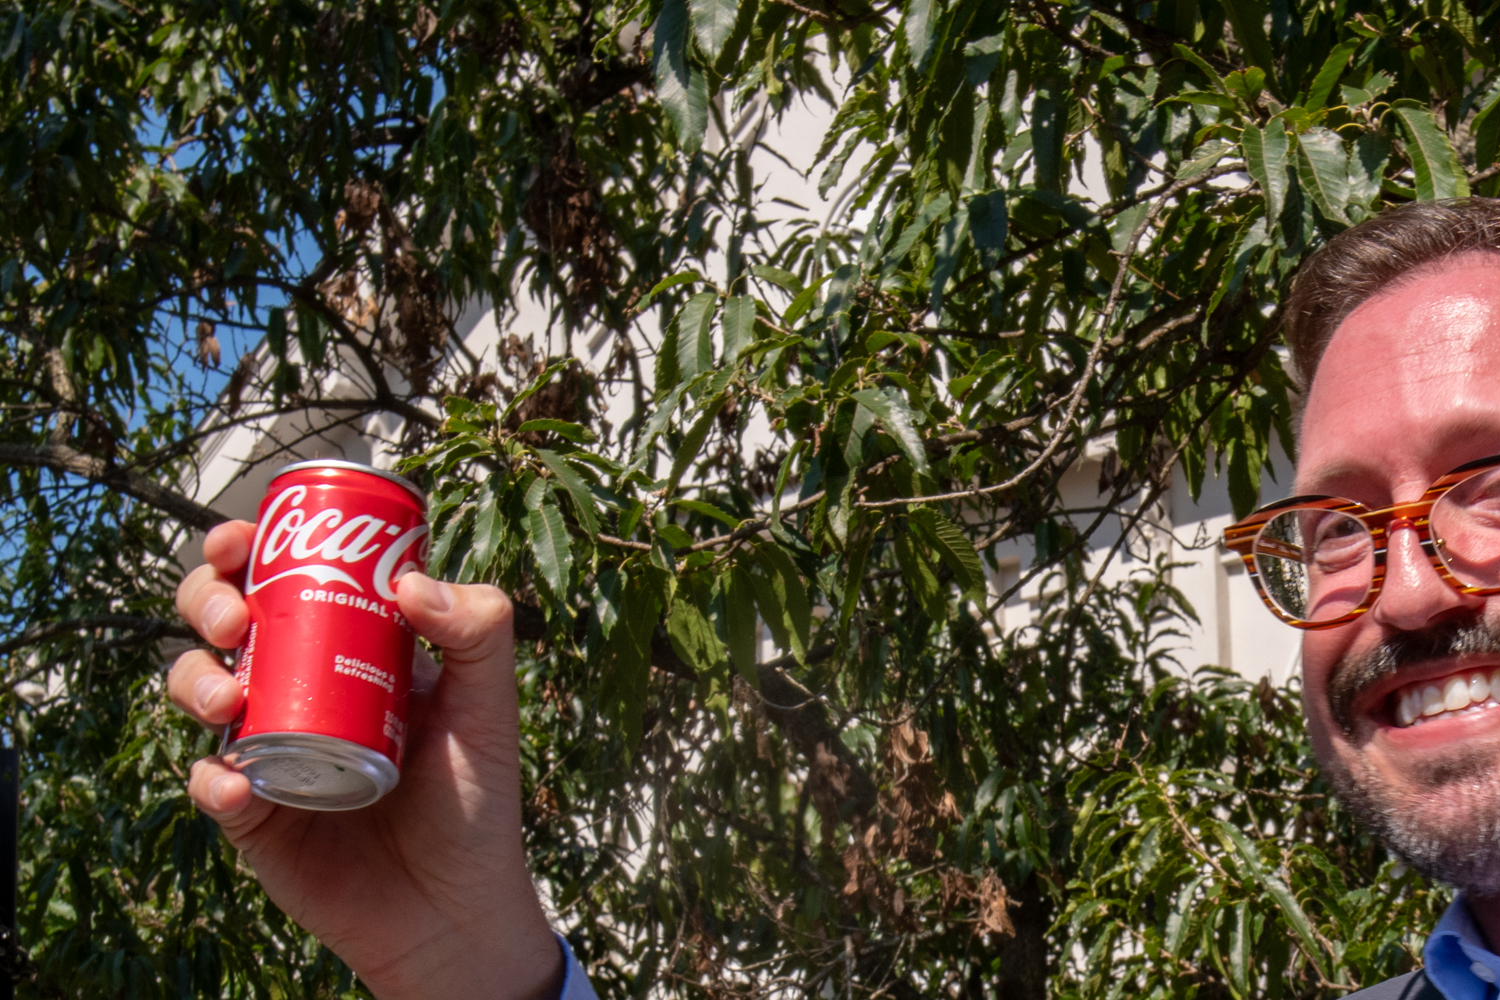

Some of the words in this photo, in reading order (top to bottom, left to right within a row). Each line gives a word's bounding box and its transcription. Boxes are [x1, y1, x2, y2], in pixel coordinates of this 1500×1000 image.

[300, 588, 389, 618] ORIGINAL
[334, 654, 388, 679] Delicious
[334, 664, 395, 693] Refreshing
